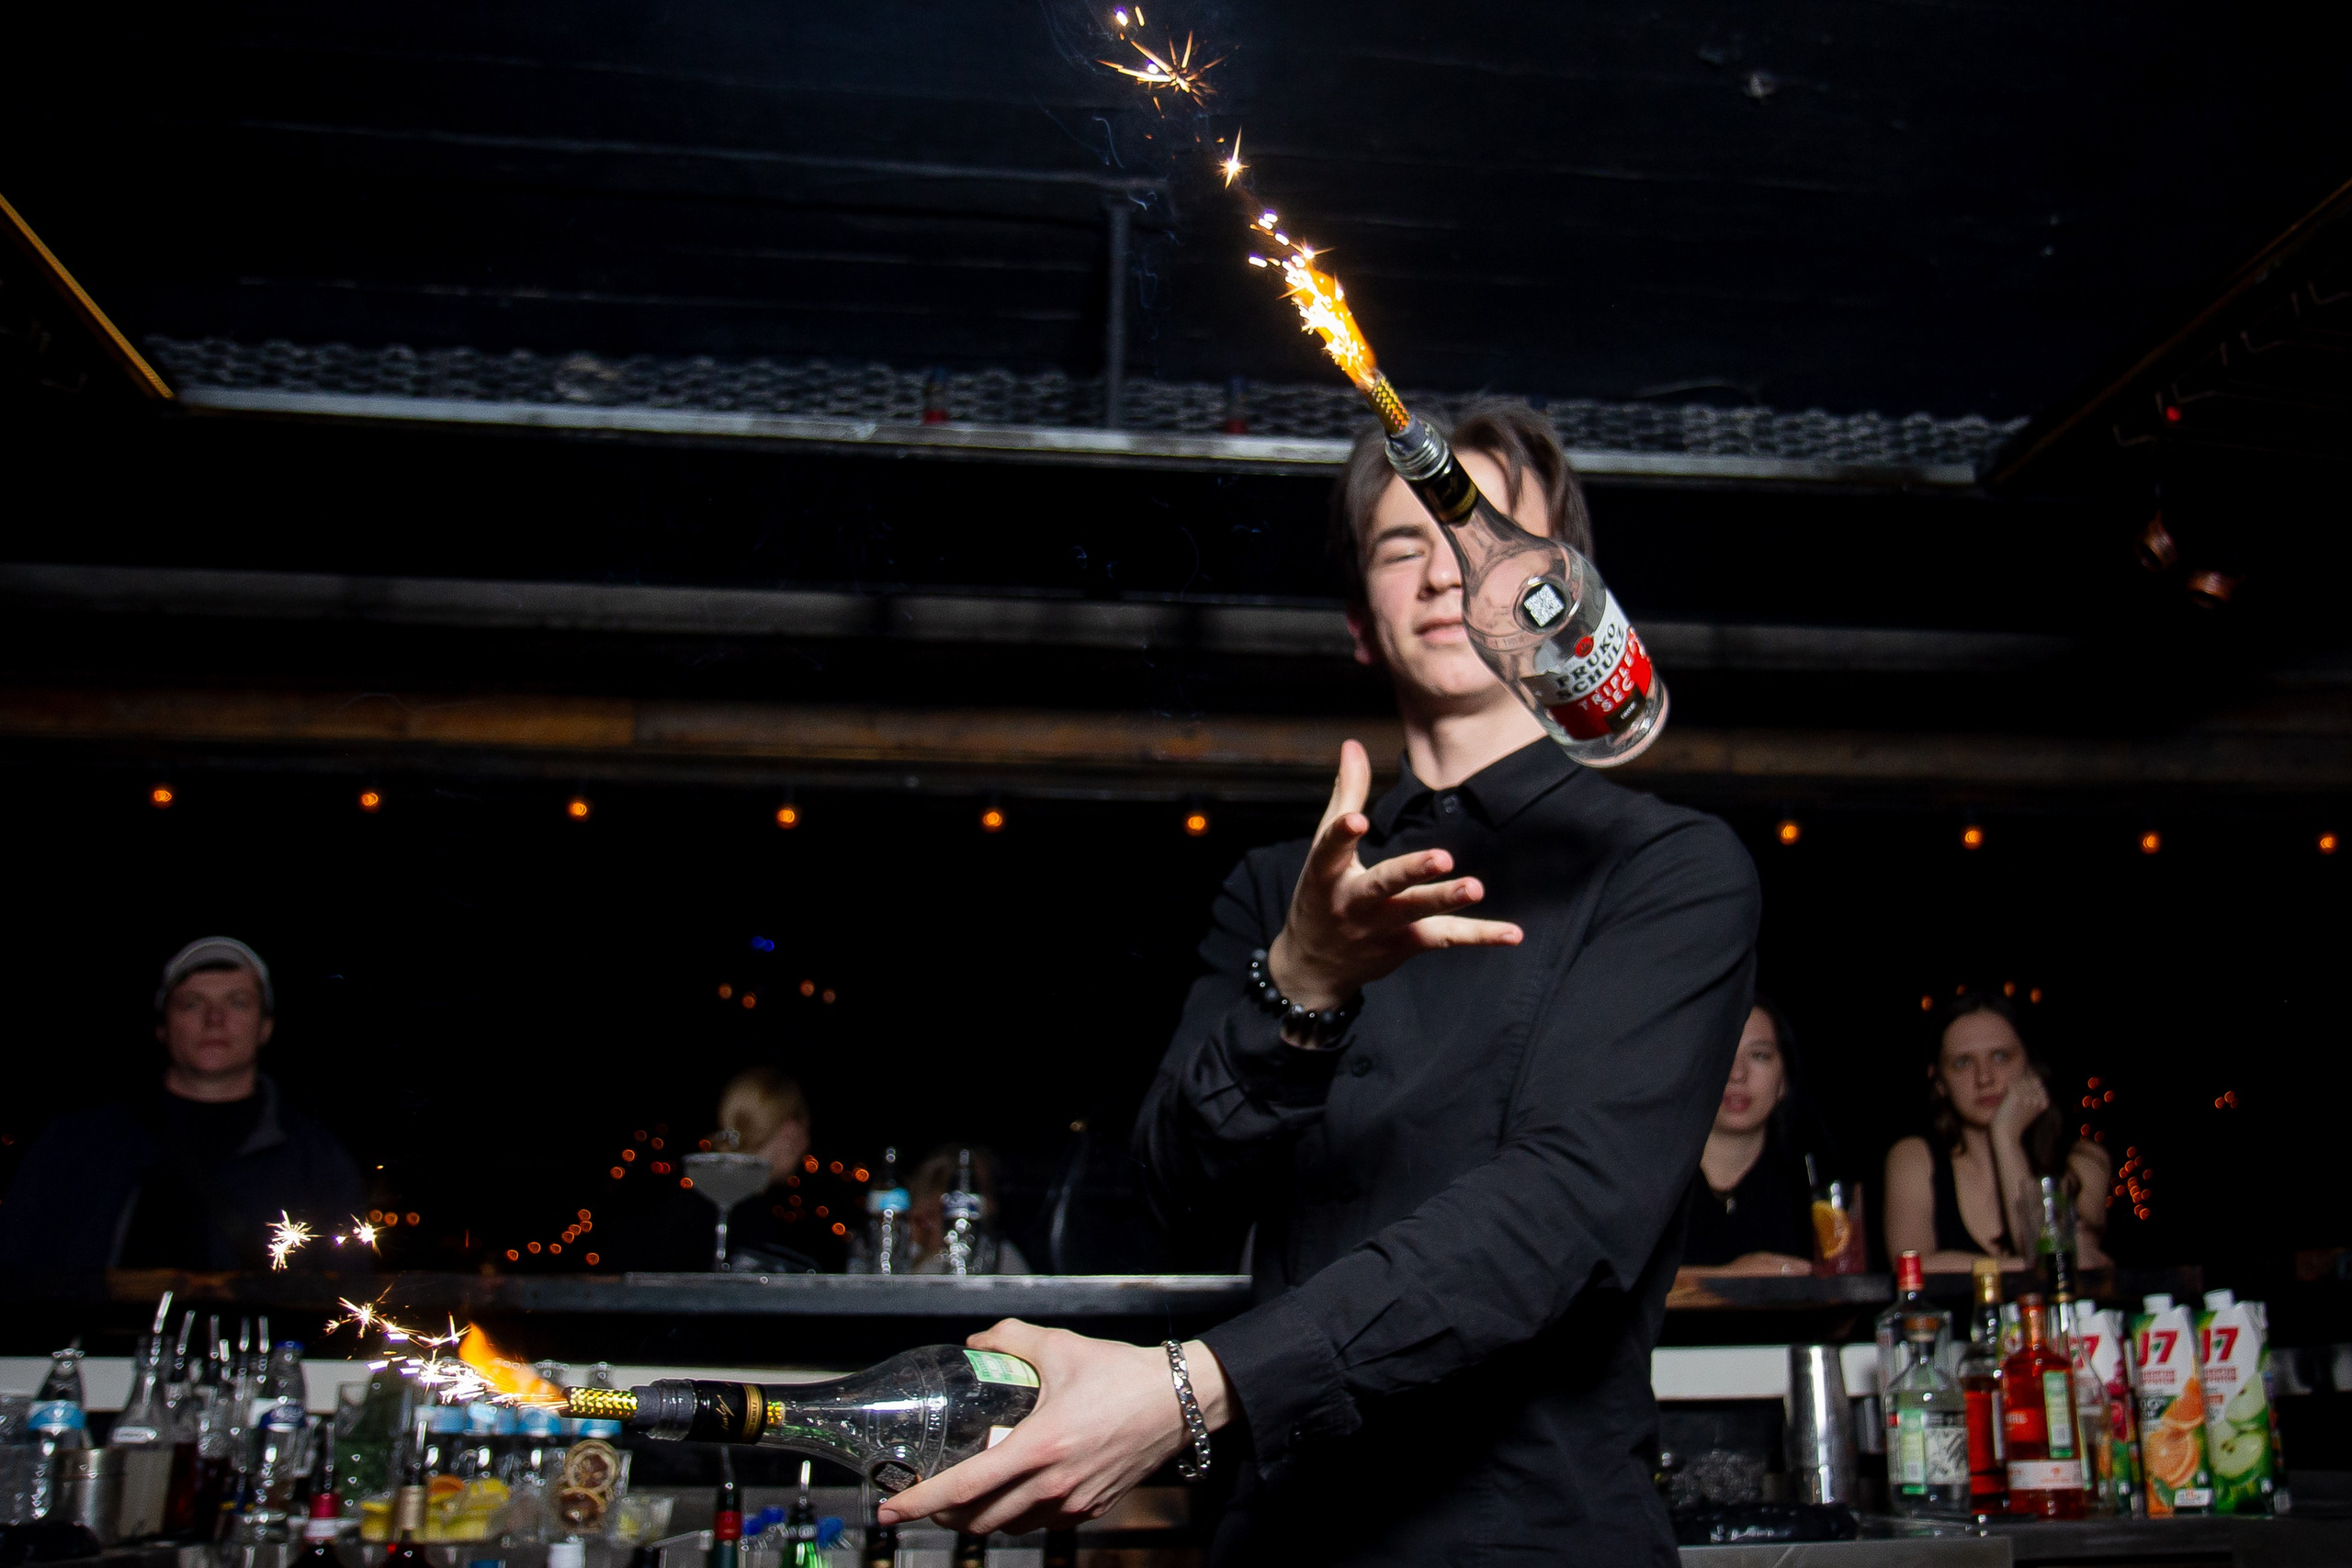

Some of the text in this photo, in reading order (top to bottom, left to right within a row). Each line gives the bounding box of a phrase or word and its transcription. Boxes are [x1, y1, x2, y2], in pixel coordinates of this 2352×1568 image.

[1556, 623, 1615, 687] FRUKO
[1556, 626, 1624, 698] SCHULZ
[1577, 651, 1634, 710] TRIPLE
[1600, 675, 1634, 712] SEC
[2138, 1328, 2178, 1367] J7
